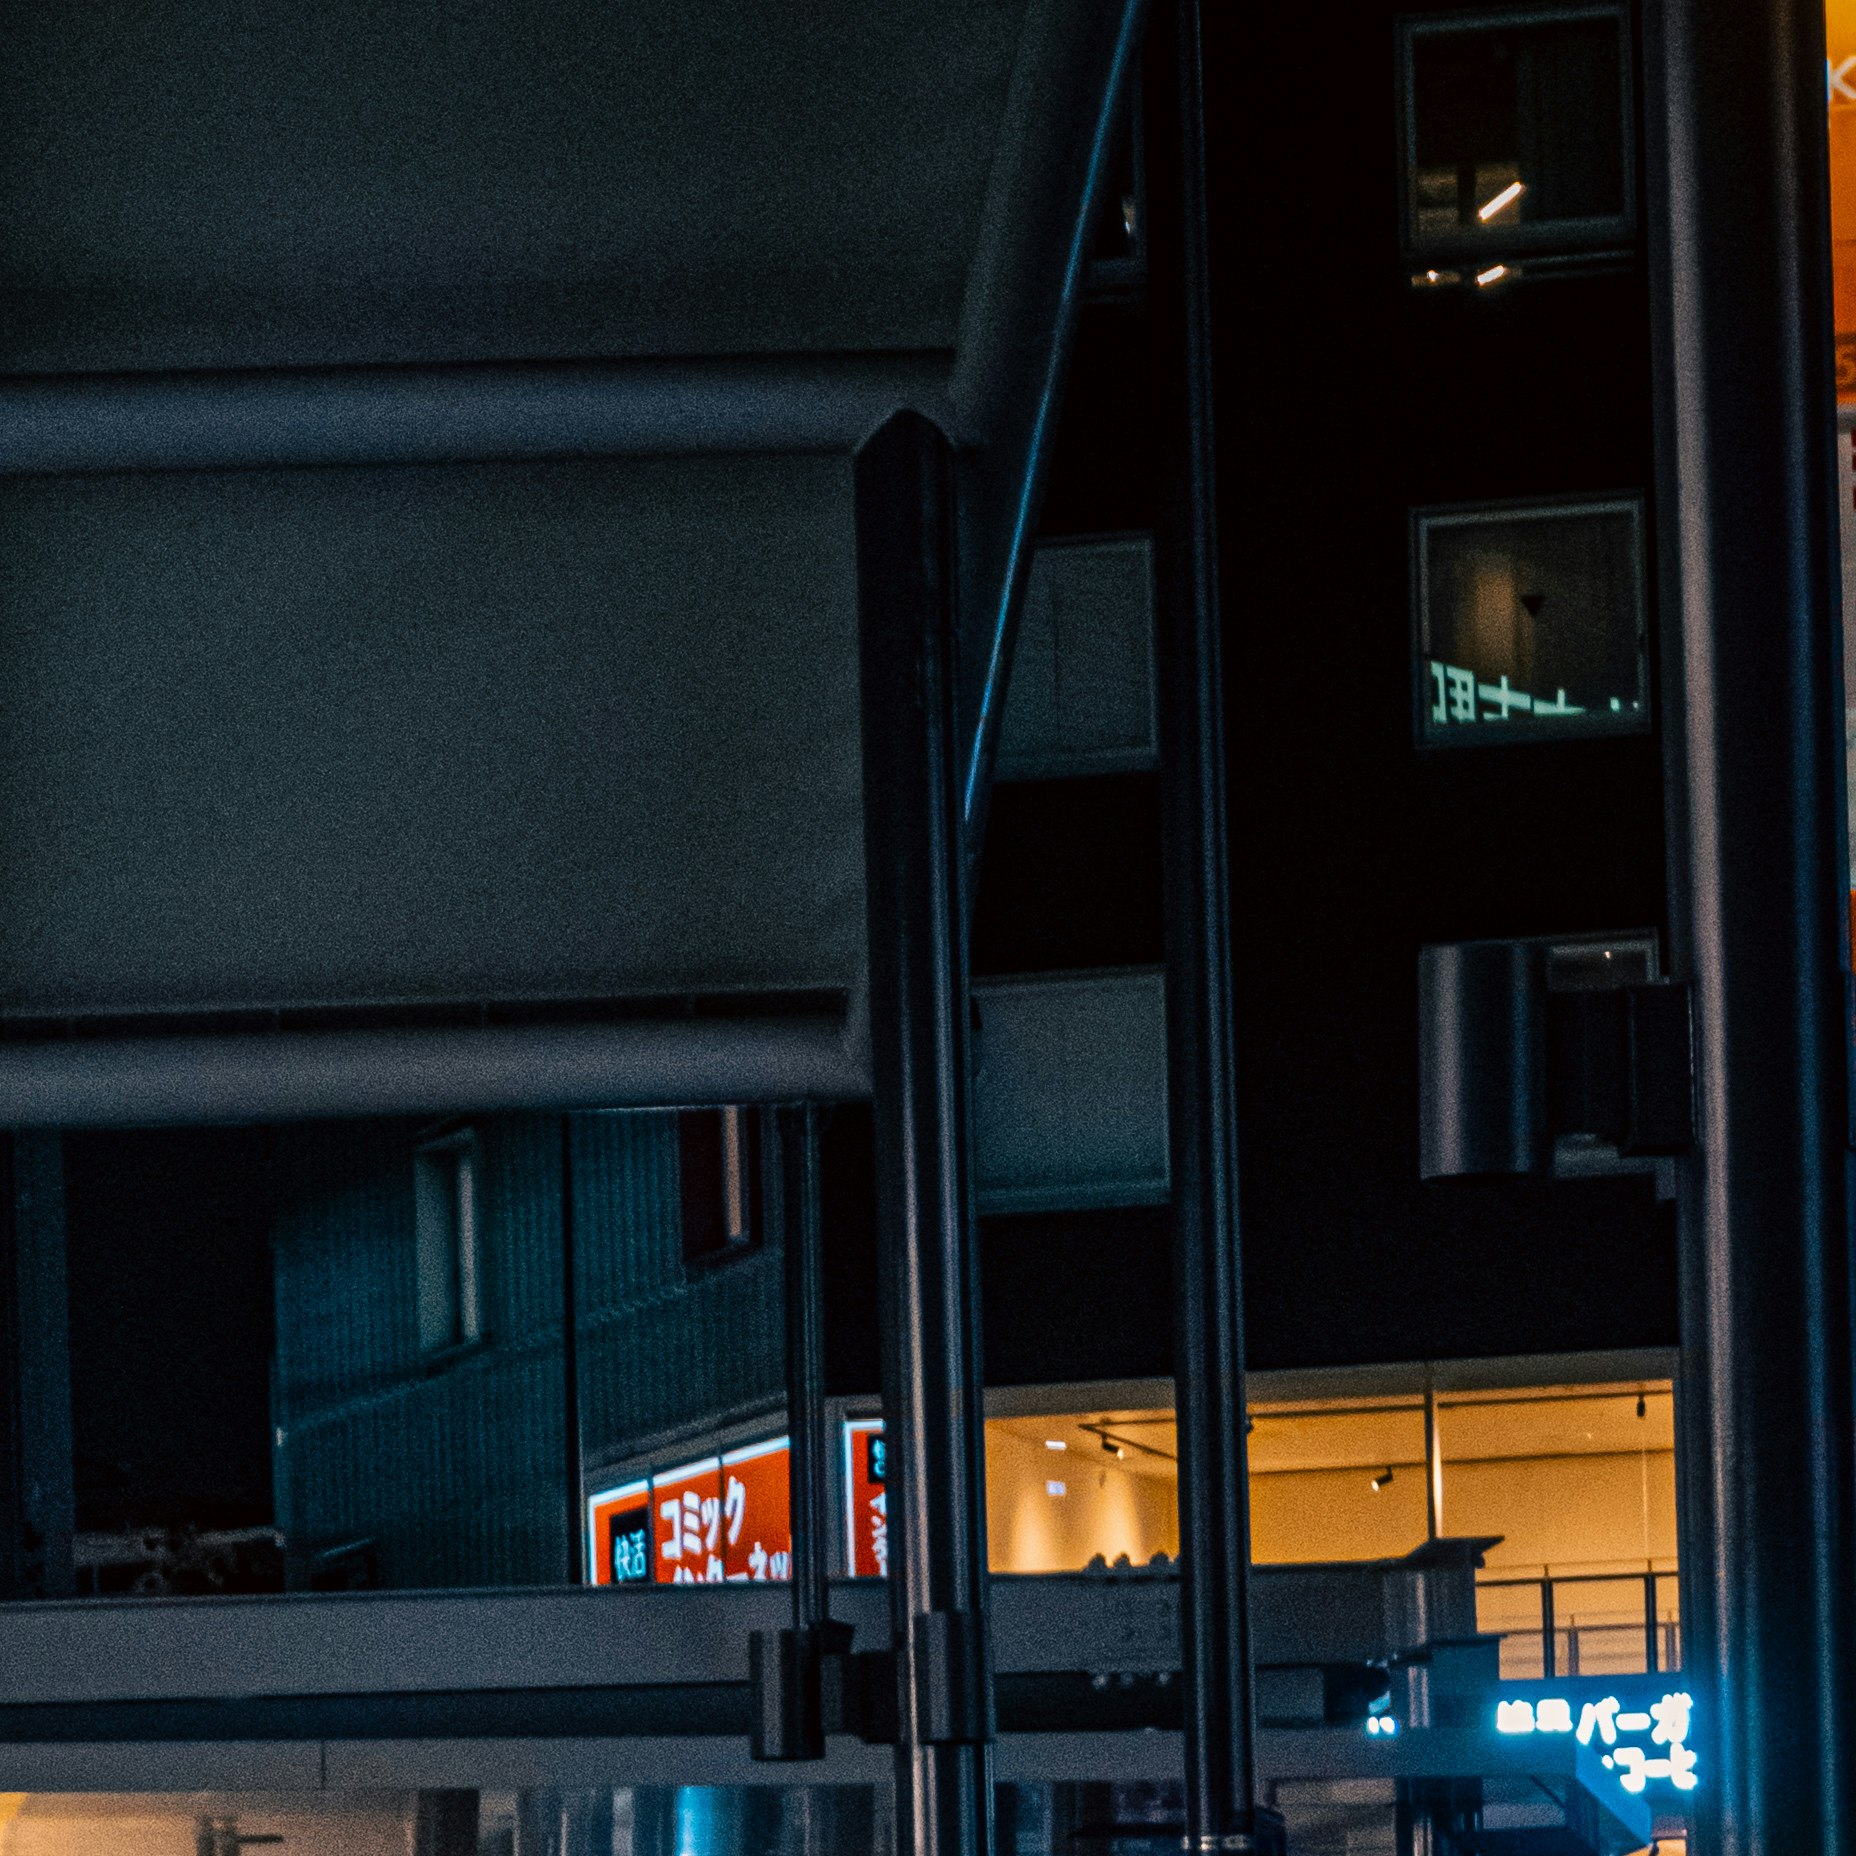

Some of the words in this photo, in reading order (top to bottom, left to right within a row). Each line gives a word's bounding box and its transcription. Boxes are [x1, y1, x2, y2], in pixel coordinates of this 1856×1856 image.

[660, 1475, 746, 1560] コミック
[614, 1528, 646, 1580] 快活
